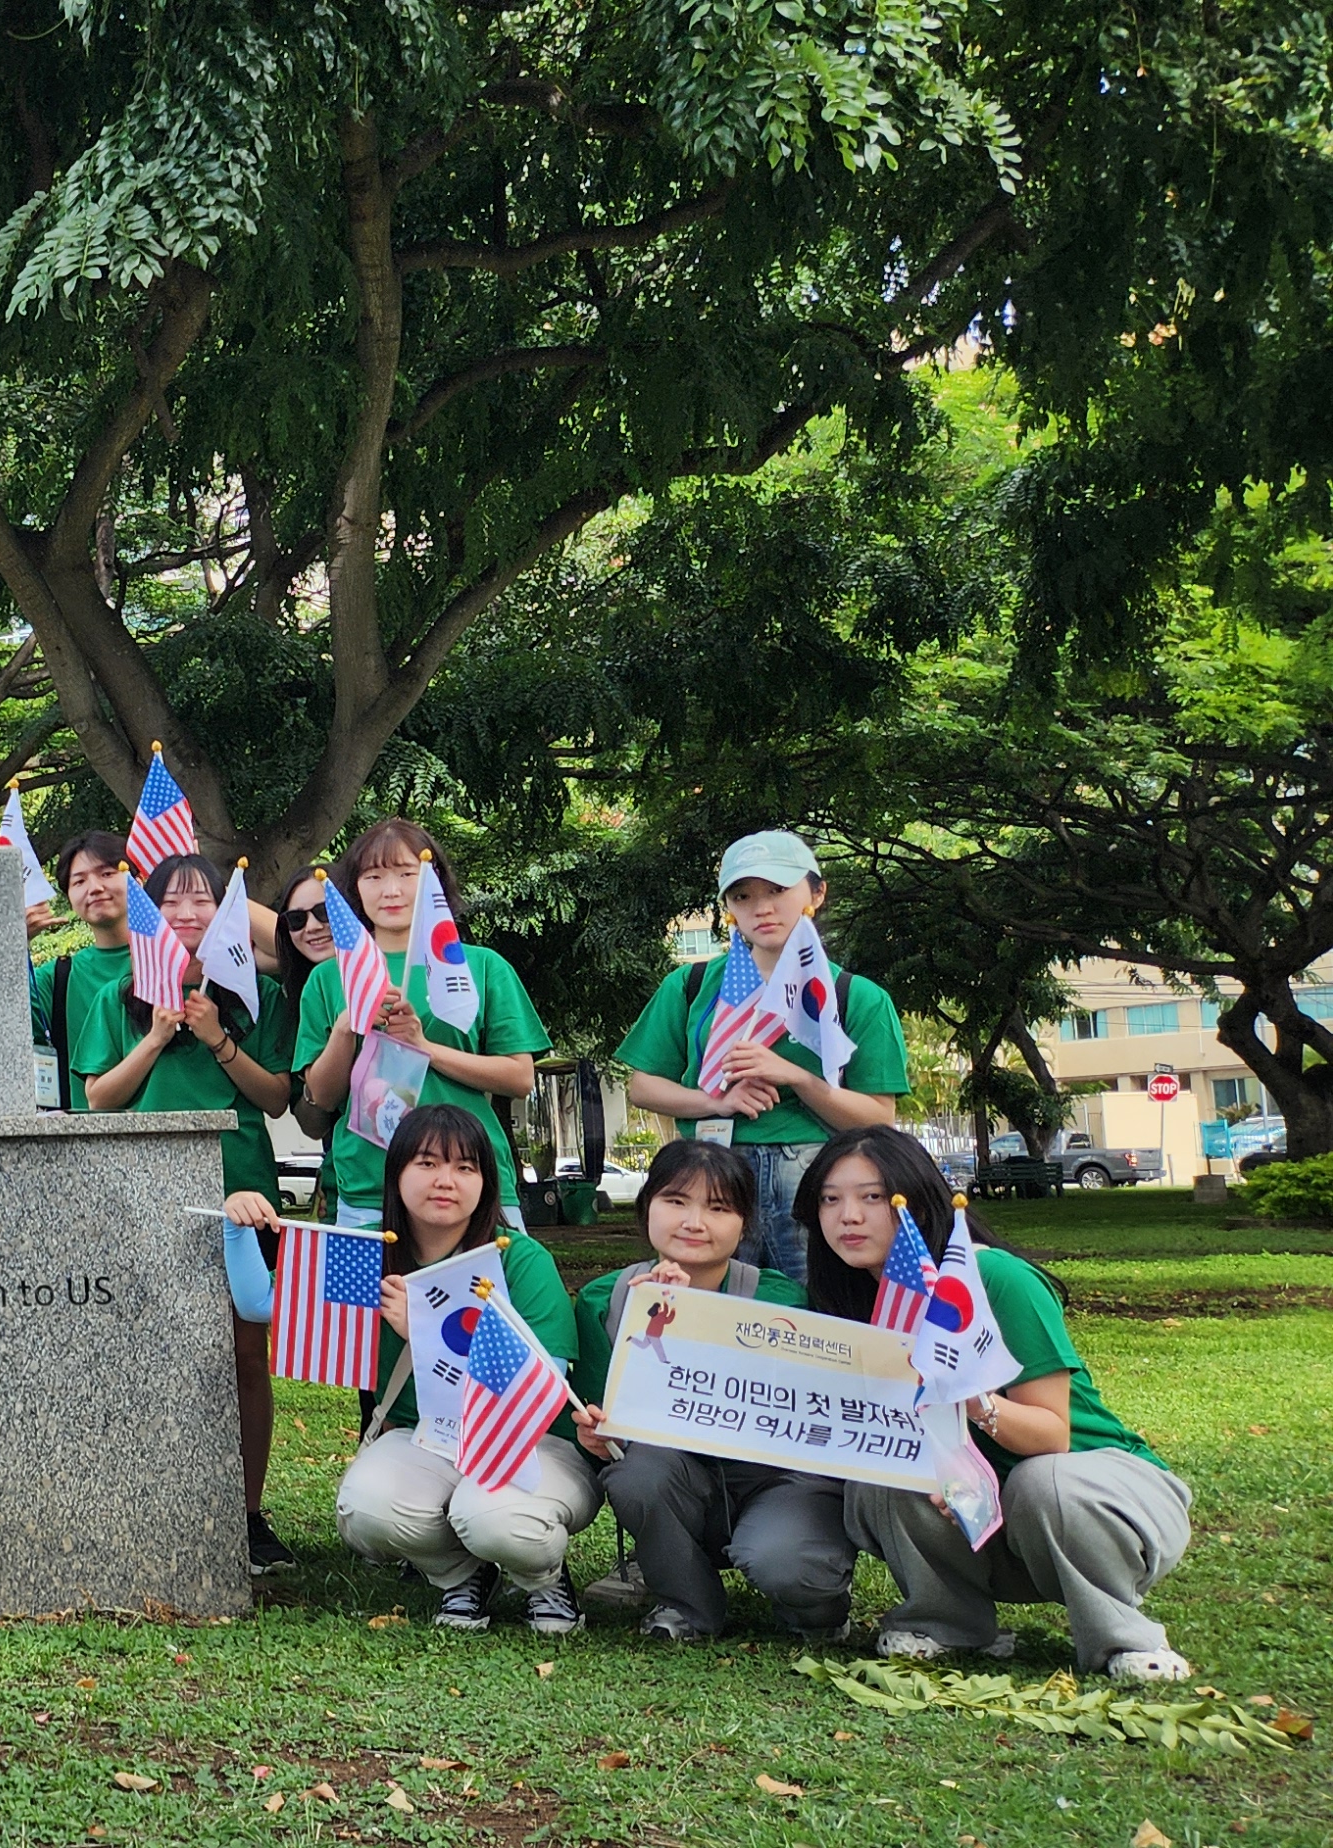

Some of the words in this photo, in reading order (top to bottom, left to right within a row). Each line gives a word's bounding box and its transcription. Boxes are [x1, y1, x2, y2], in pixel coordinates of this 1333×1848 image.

[1151, 1083, 1177, 1095] STOP
[18, 1279, 53, 1307] to
[67, 1275, 113, 1306] US
[667, 1365, 716, 1396] 한인
[724, 1376, 796, 1412] 이민의
[806, 1391, 831, 1418] 첫
[840, 1397, 925, 1435] 발자취,
[667, 1398, 747, 1432] 희망의
[754, 1415, 832, 1447] 역사를
[837, 1430, 922, 1462] 기리며
